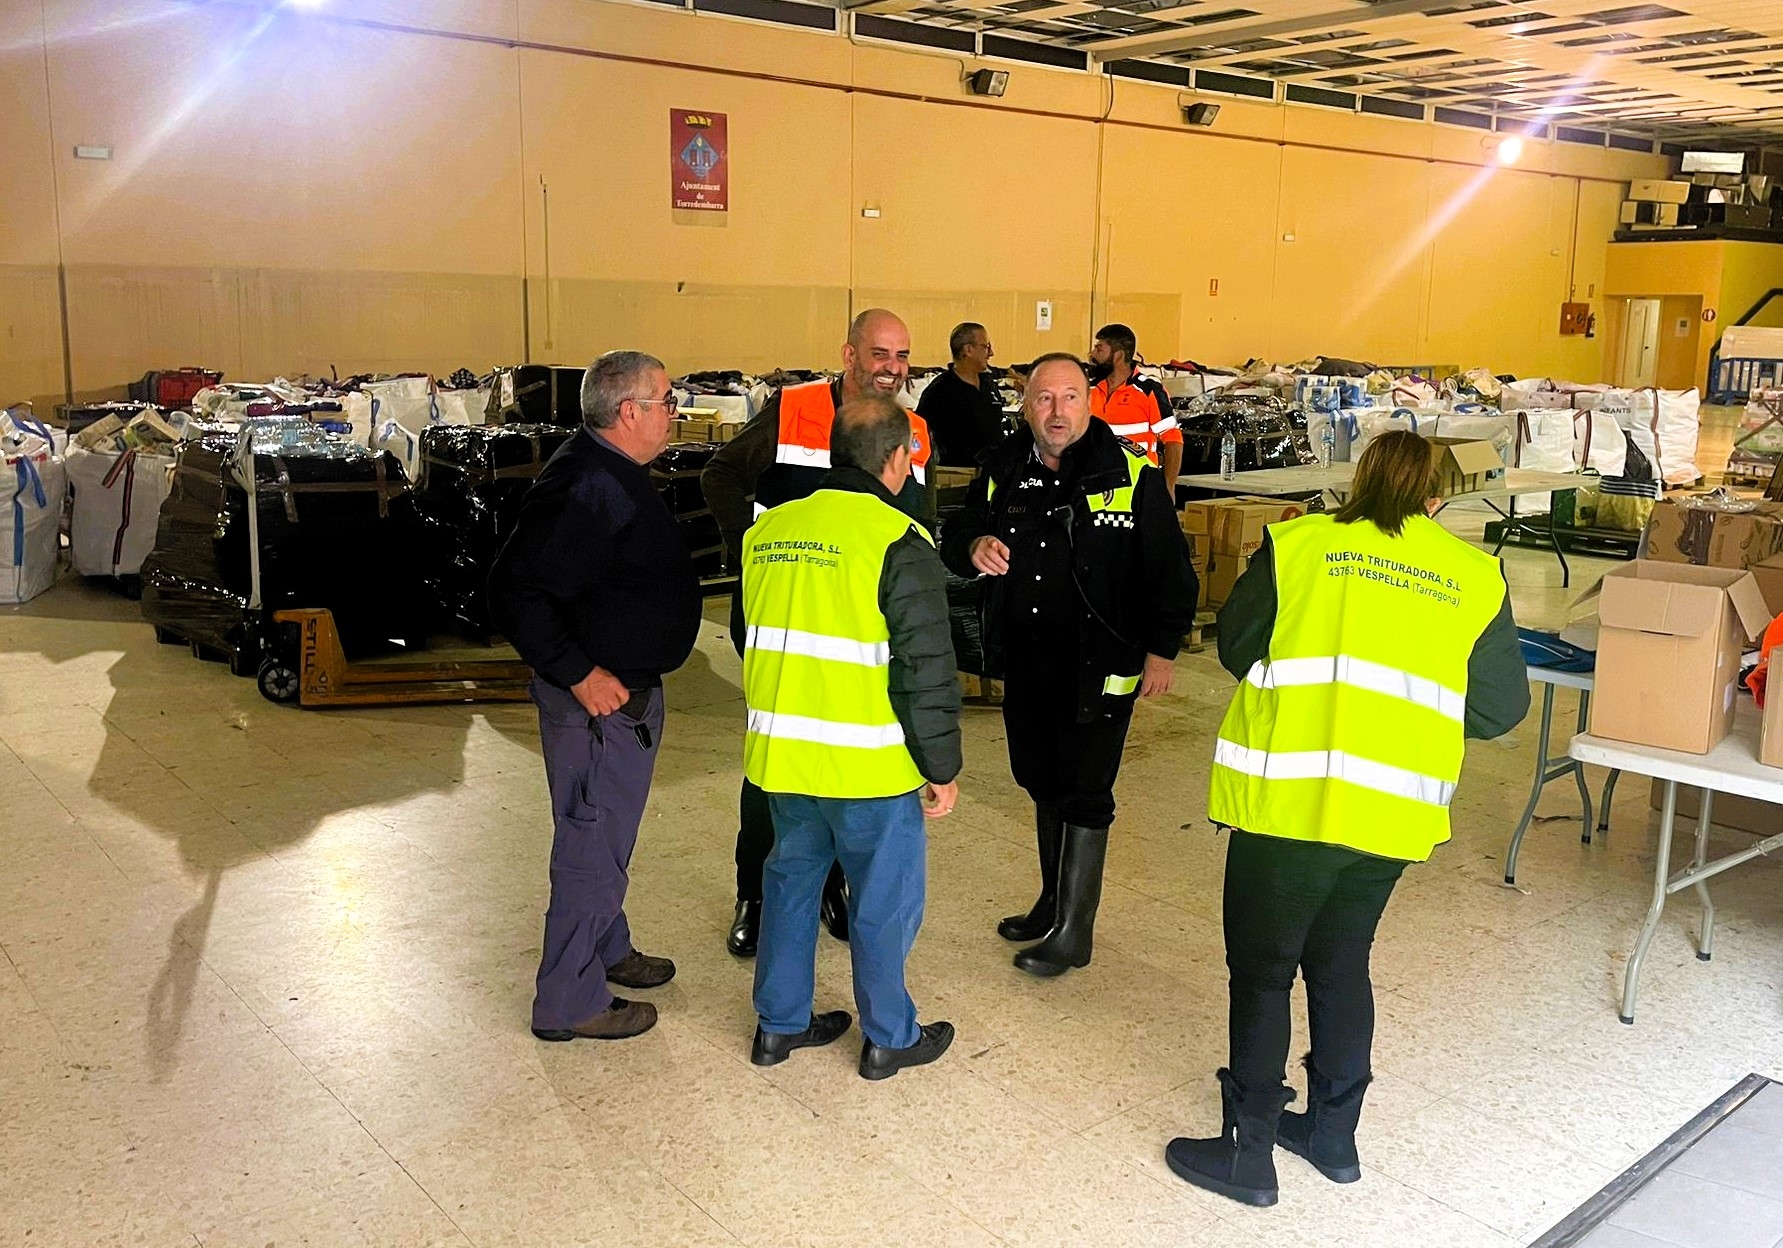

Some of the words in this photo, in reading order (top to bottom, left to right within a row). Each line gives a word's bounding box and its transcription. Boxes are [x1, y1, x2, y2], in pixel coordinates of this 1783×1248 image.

[680, 181, 720, 191] Ajuntament
[696, 192, 704, 200] de
[676, 200, 724, 210] Torredembarra
[753, 542, 772, 553] NUEVA
[773, 541, 826, 553] TRITURADORA,
[766, 553, 799, 563] VESPELLA
[1325, 551, 1364, 563] NUEVA
[1367, 555, 1443, 587] TRITURADORA,
[1328, 565, 1355, 577] 43763
[1358, 567, 1410, 590] VESPELLA
[1412, 582, 1461, 608] (Tarragona)
[305, 618, 317, 673] STILL
